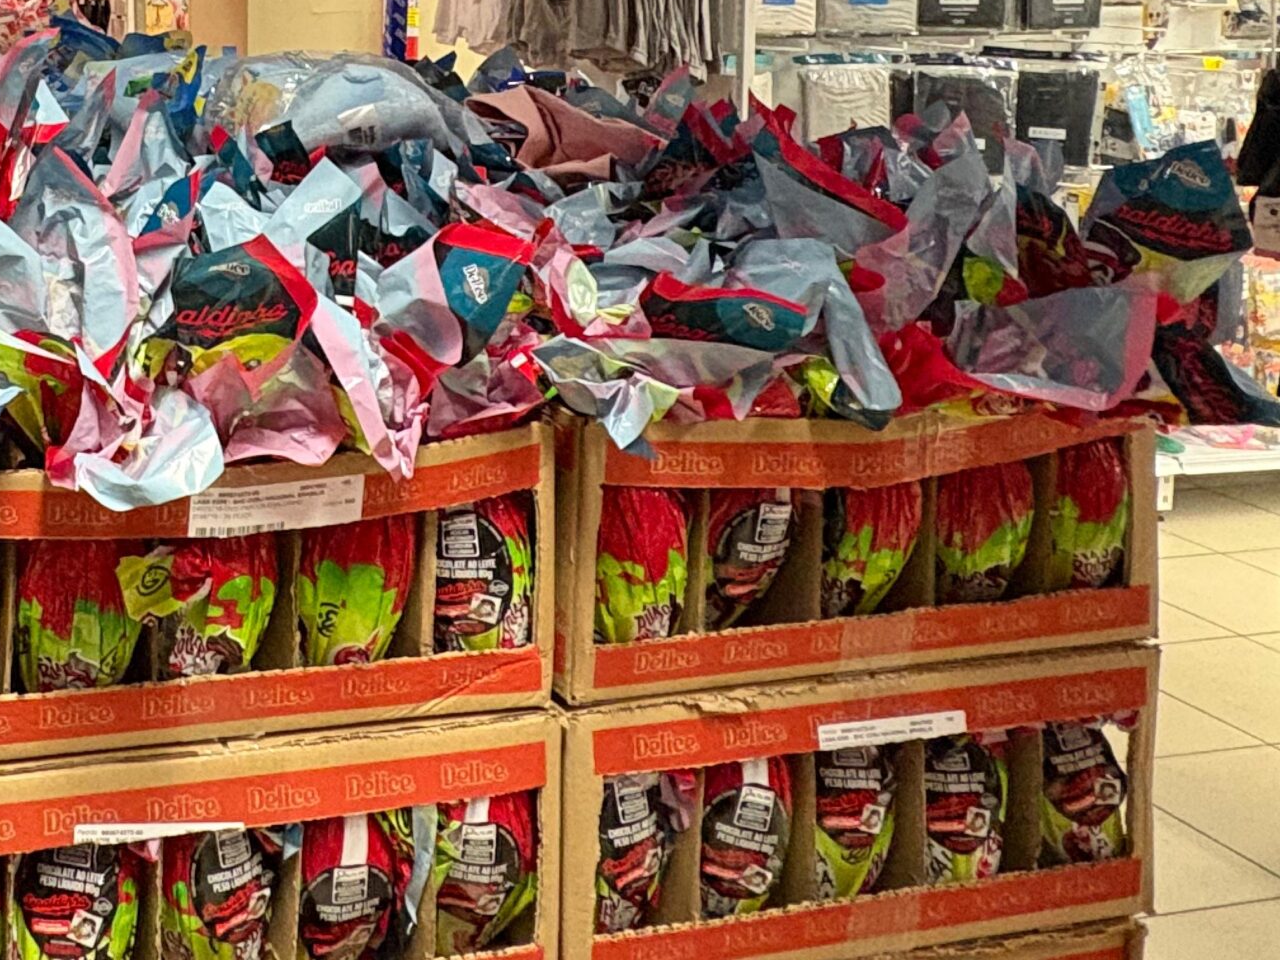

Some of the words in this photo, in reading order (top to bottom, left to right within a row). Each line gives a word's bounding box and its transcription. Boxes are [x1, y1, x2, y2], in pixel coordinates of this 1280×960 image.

[449, 463, 507, 491] Delice
[650, 450, 724, 475] Delice
[751, 452, 823, 475] Delice
[634, 648, 700, 673] Delice
[722, 640, 787, 665] Delice
[40, 703, 115, 730] Delice
[143, 693, 216, 720] Delice
[246, 683, 314, 708] Delice
[340, 672, 410, 698] Delice
[633, 731, 700, 758] Delice
[723, 720, 787, 747] Delice
[147, 793, 218, 823] Delice
[247, 782, 320, 813] Delice
[346, 771, 416, 801] Delice
[440, 760, 508, 786] Delice
